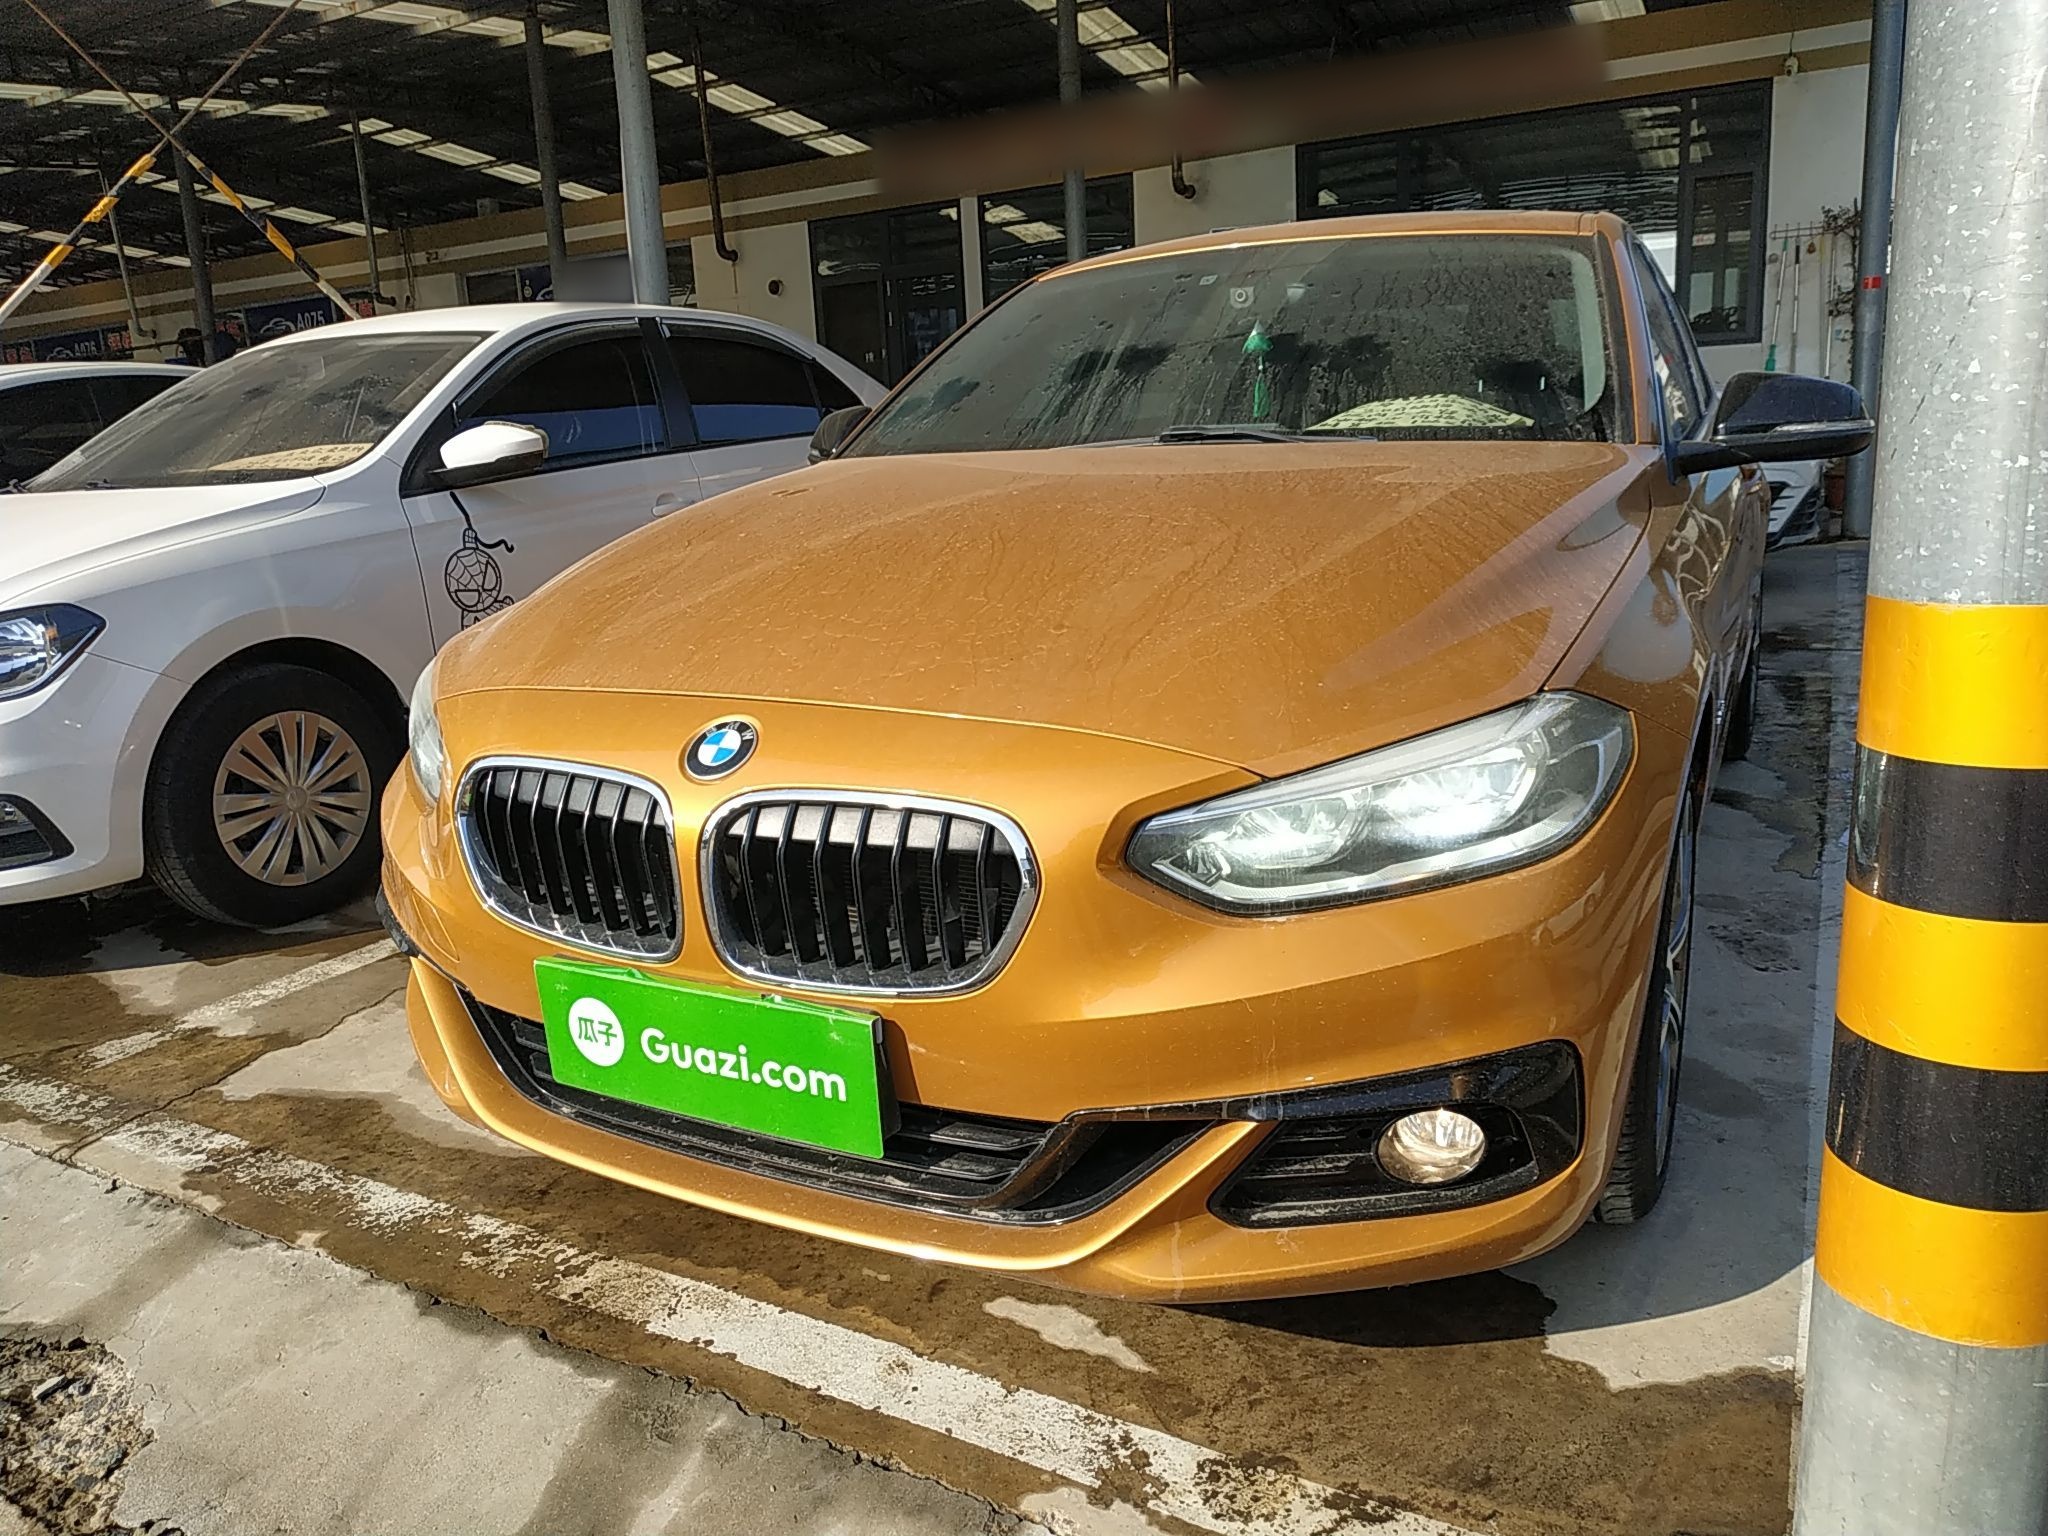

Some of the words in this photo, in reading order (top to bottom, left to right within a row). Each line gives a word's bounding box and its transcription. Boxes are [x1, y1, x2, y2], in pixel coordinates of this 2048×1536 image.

[297, 310, 326, 331] A075
[577, 1016, 618, 1048] 瓜子
[640, 1027, 847, 1102] Guazi.com
